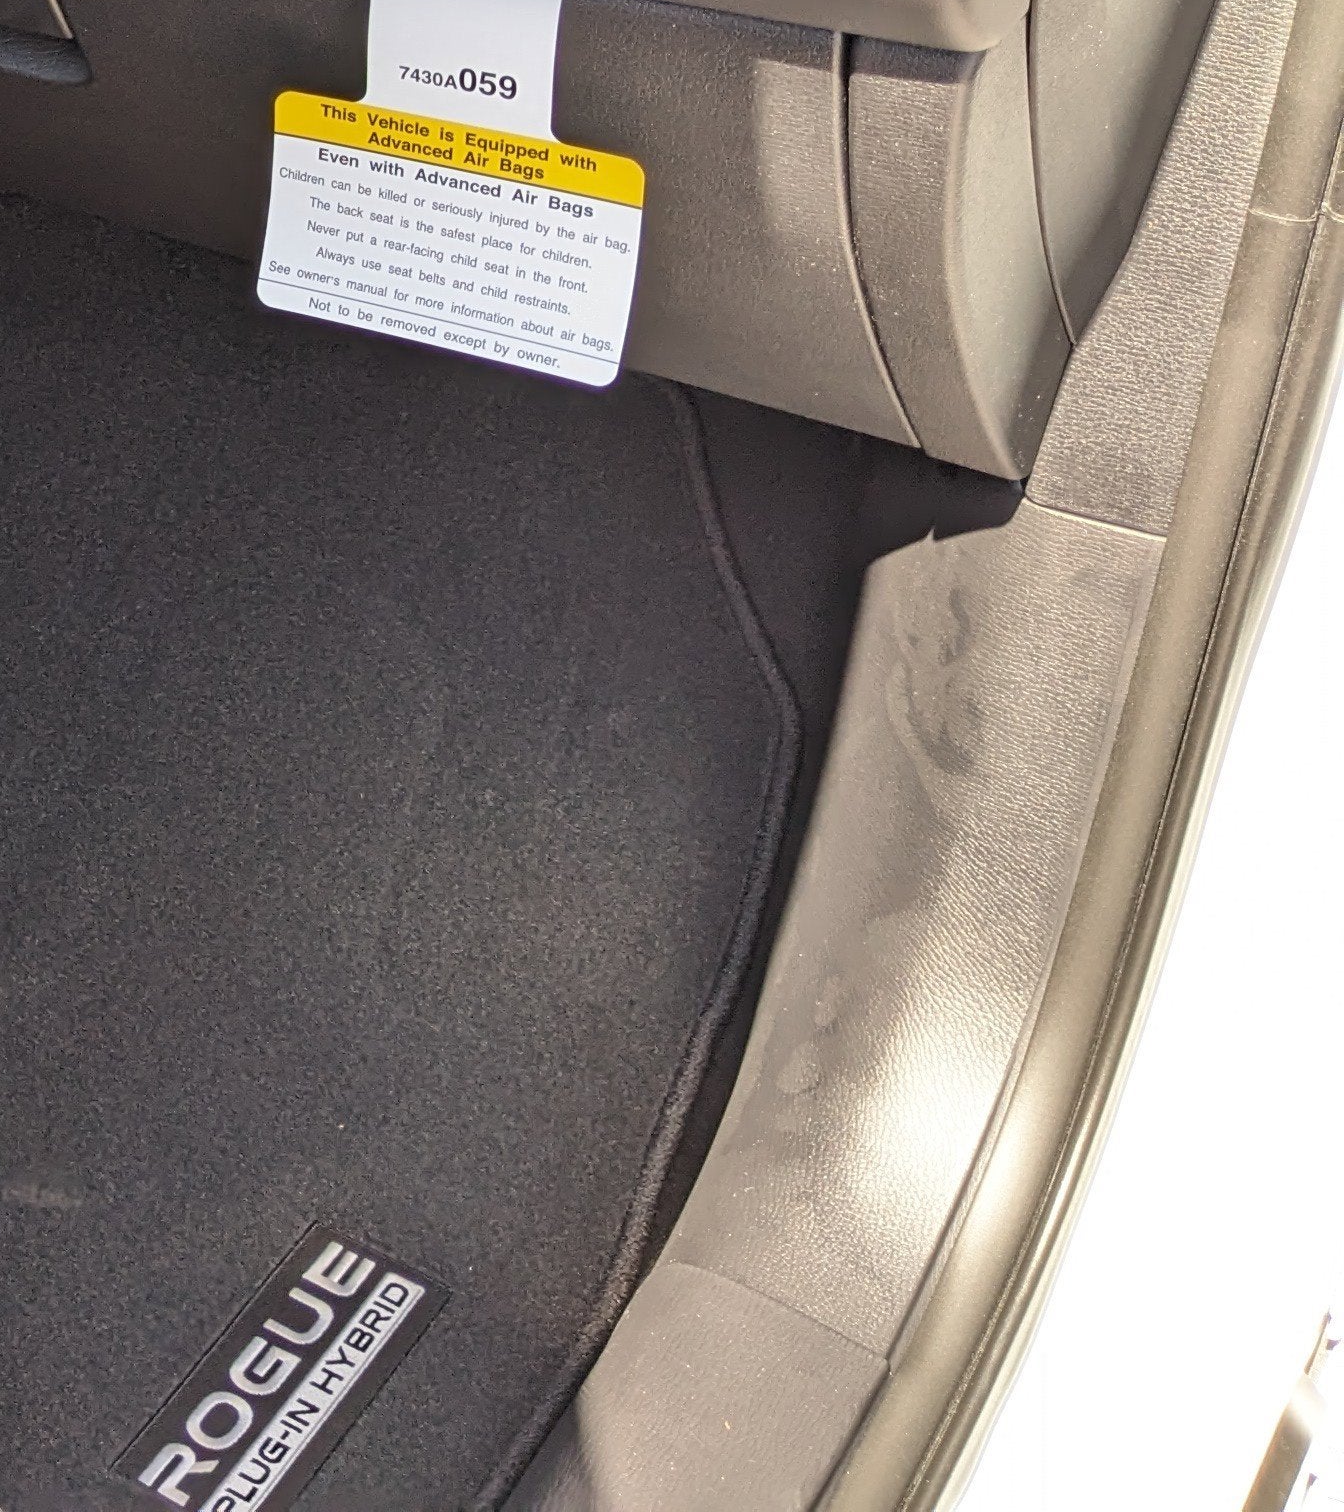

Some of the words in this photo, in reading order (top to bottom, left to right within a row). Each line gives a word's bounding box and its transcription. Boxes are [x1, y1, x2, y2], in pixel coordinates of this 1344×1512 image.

[320, 103, 357, 123] This
[367, 112, 430, 137] Vehicle
[439, 127, 454, 143] is
[465, 132, 550, 162] Equipped
[559, 154, 597, 172] with
[367, 131, 453, 161] Advanced
[463, 151, 490, 168] Air
[499, 157, 544, 181] Bags
[279, 166, 325, 187] Children
[331, 180, 352, 192] can
[357, 183, 372, 196] be
[378, 187, 408, 204] killed
[413, 197, 426, 208] or
[431, 201, 483, 223] seriously
[489, 211, 529, 231] injured
[535, 221, 551, 237] by
[557, 226, 576, 240] the
[582, 232, 598, 245] air
[605, 236, 631, 254] bag.
[318, 147, 359, 168] Even
[369, 160, 404, 178] with
[414, 168, 502, 198] Advanced
[511, 188, 538, 205] Air
[548, 195, 594, 218] Bags
[306, 219, 341, 237] Never
[345, 231, 364, 243] put
[369, 236, 377, 246] a
[383, 239, 444, 264] rear-facing
[450, 253, 478, 268] child
[484, 262, 510, 276] seat
[515, 266, 526, 279] in
[533, 270, 551, 285] the
[558, 276, 588, 293] front.
[309, 195, 331, 211] The
[336, 202, 364, 219] back
[369, 212, 394, 225] seat
[399, 215, 410, 229] is
[416, 220, 434, 234] the
[440, 227, 476, 243] safest
[480, 235, 513, 251] place
[520, 242, 536, 256] for
[542, 248, 592, 269] children.
[268, 260, 291, 275] See
[296, 269, 340, 287] owner's
[346, 280, 388, 298] manual
[393, 288, 409, 302] for
[415, 296, 445, 311] more
[450, 301, 514, 327] information
[520, 320, 554, 337] about
[560, 329, 576, 342] air
[582, 332, 613, 352] bags.
[315, 246, 355, 266] Always
[361, 259, 382, 272] use
[388, 265, 413, 279] seat
[418, 269, 446, 286] belts
[452, 279, 475, 293] and
[480, 285, 508, 300] child
[514, 293, 570, 315] restraints.
[308, 297, 331, 313] Not
[338, 304, 350, 317] to
[357, 308, 373, 322] be
[380, 316, 437, 337] removed
[443, 331, 487, 351] except
[493, 340, 510, 358] by
[517, 349, 560, 369] owner.
[137, 1241, 376, 1508] ROGUE
[212, 1397, 321, 1512] PLUG-IN
[308, 1282, 410, 1396] HYBRID
